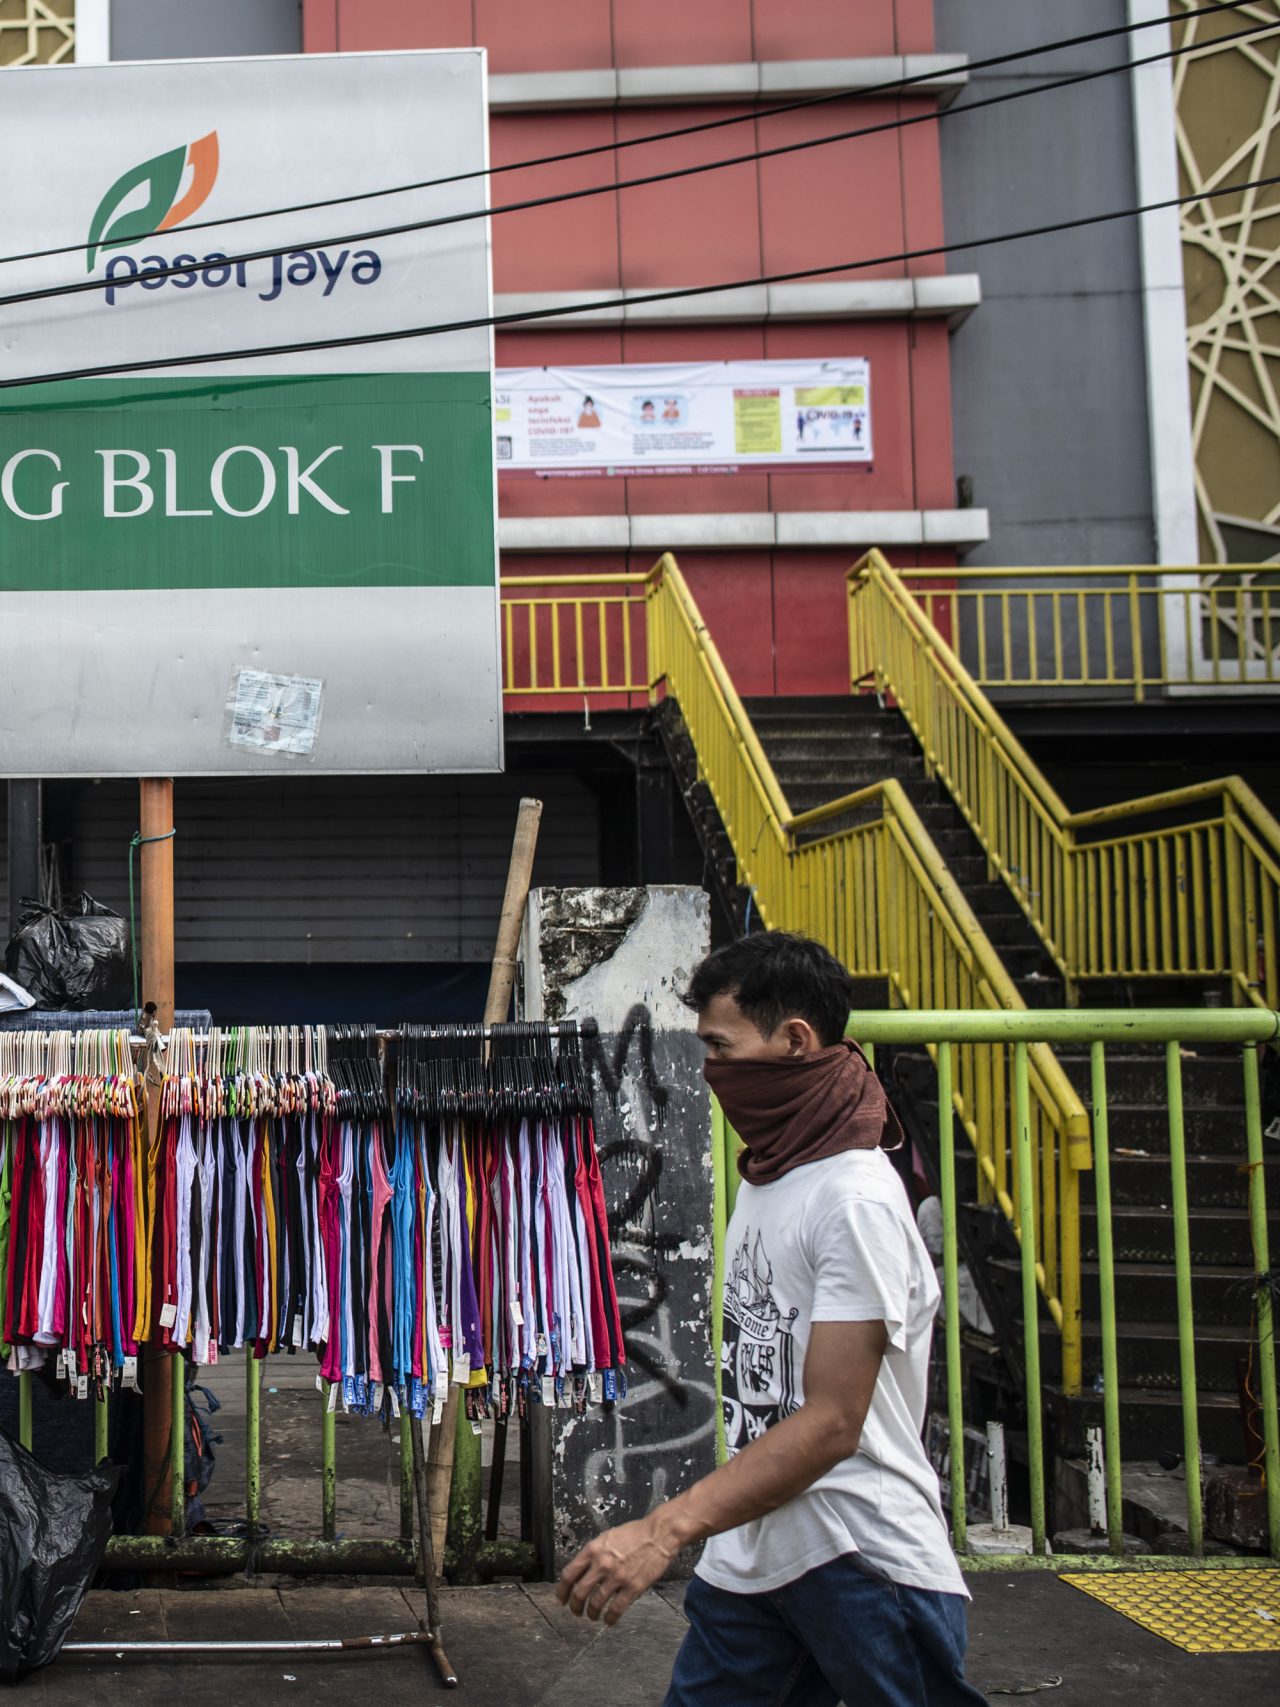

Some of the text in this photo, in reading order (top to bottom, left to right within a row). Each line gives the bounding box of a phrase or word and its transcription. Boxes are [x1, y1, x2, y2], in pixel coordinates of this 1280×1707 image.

[104, 249, 382, 306] pasar jaya
[94, 445, 350, 518] BLOK
[371, 444, 424, 514] F
